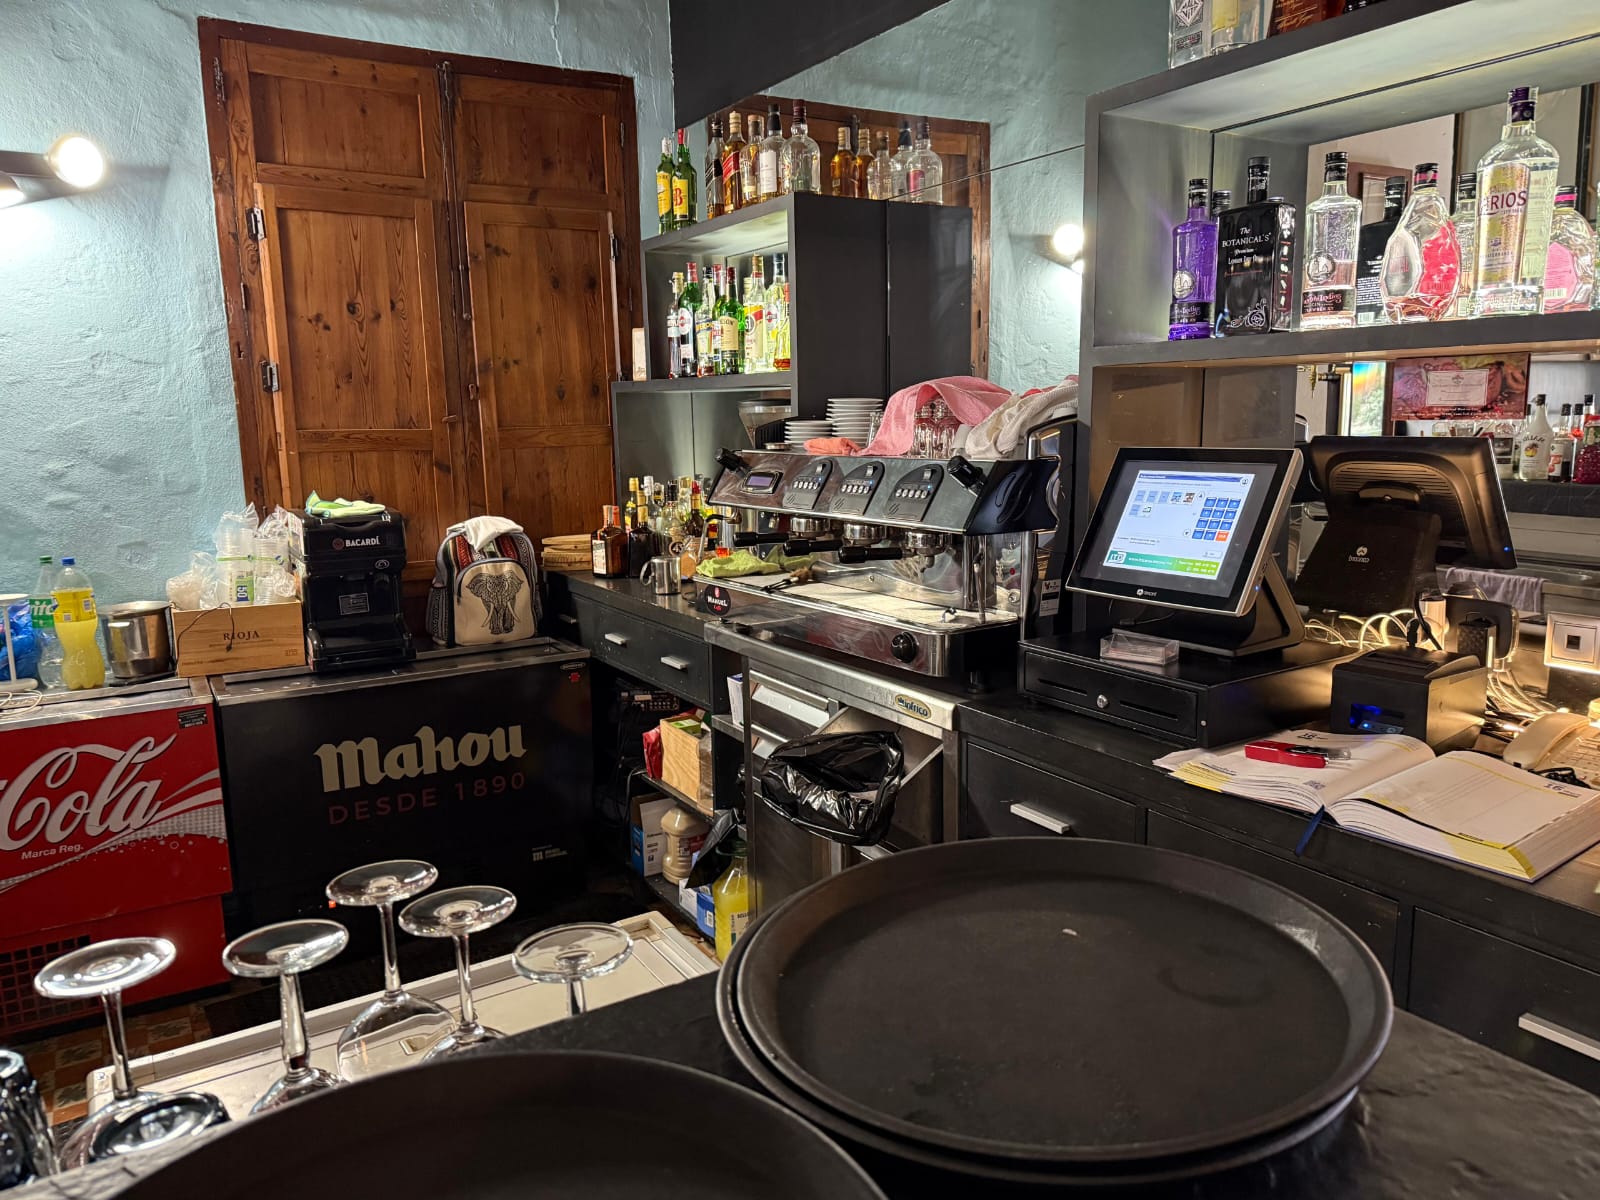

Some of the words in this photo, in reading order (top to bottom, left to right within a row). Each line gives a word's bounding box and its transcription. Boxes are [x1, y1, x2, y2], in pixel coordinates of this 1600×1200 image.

[345, 535, 380, 547] BACARDÍ
[223, 630, 260, 641] RIOJA
[313, 725, 527, 793] Mahou
[328, 787, 437, 825] DESDE
[455, 772, 526, 801] 1890
[21, 847, 56, 860] Marca
[59, 843, 84, 854] Reg.
